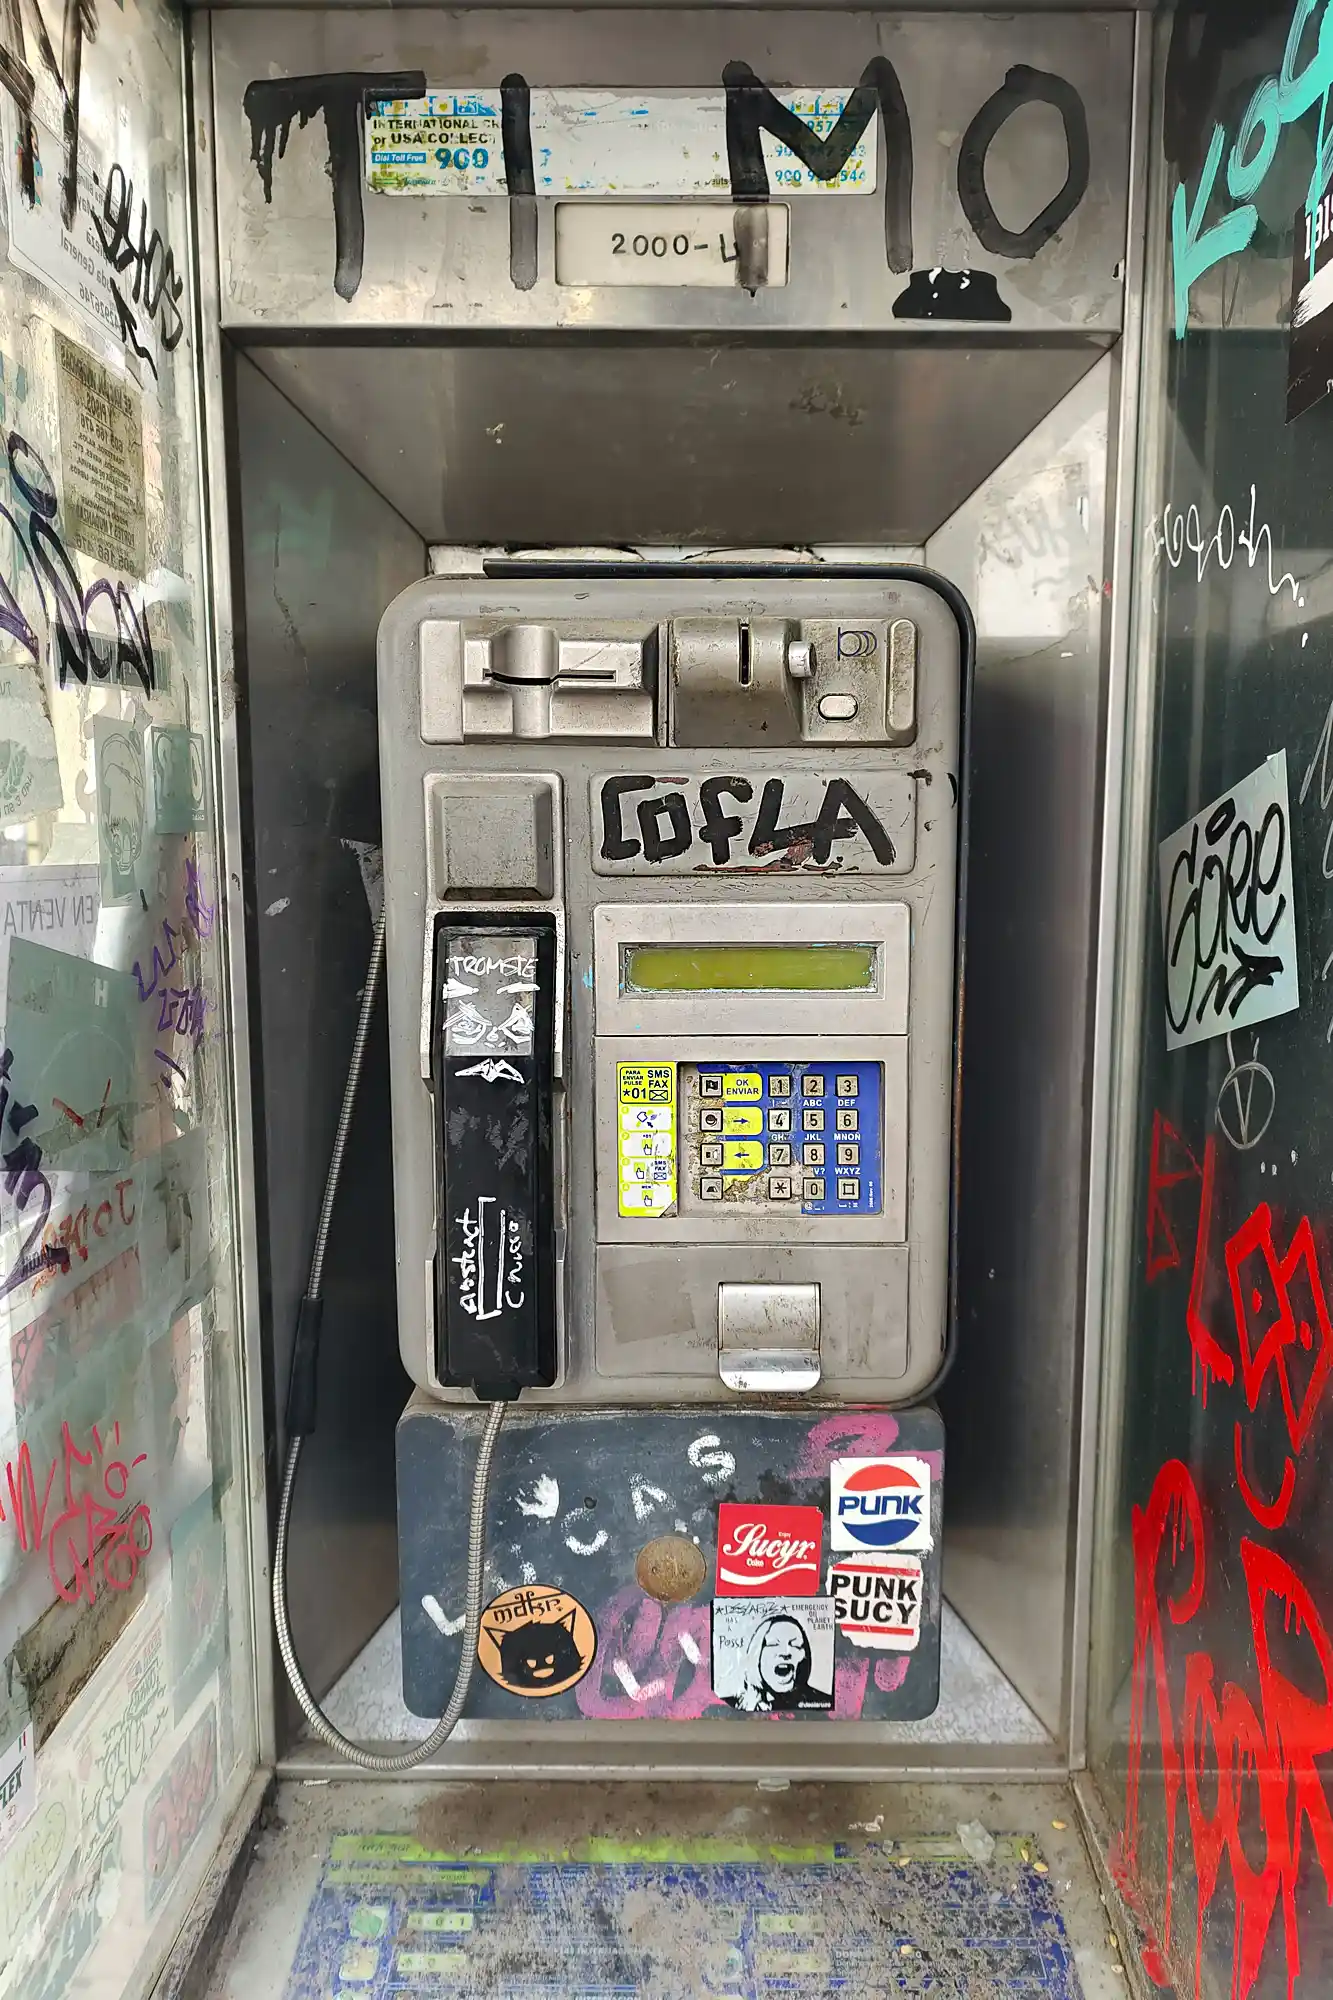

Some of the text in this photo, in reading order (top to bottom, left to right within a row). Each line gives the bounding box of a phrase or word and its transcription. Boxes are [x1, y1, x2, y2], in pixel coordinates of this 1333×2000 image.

[374, 135, 387, 145] or
[391, 133, 422, 144] USA
[374, 153, 425, 162] Dial Toll Free
[435, 147, 489, 170] 900
[647, 1069, 670, 1078] SMS
[648, 1079, 669, 1088] FAX
[735, 1079, 749, 1087] OK
[809, 1079, 818, 1093] 2
[843, 1079, 852, 1093] 3
[726, 1087, 759, 1095] ENVIAR
[803, 1099, 856, 1107] ABC DEF
[775, 1112, 852, 1127] 4 5 6
[804, 1133, 822, 1141] JKL
[775, 1148, 853, 1162] 7 8 9
[834, 1167, 861, 1175] WXYZ
[810, 1183, 818, 1196] 0
[830, 1573, 918, 1602] PUNK
[834, 1597, 917, 1625] SUCY
